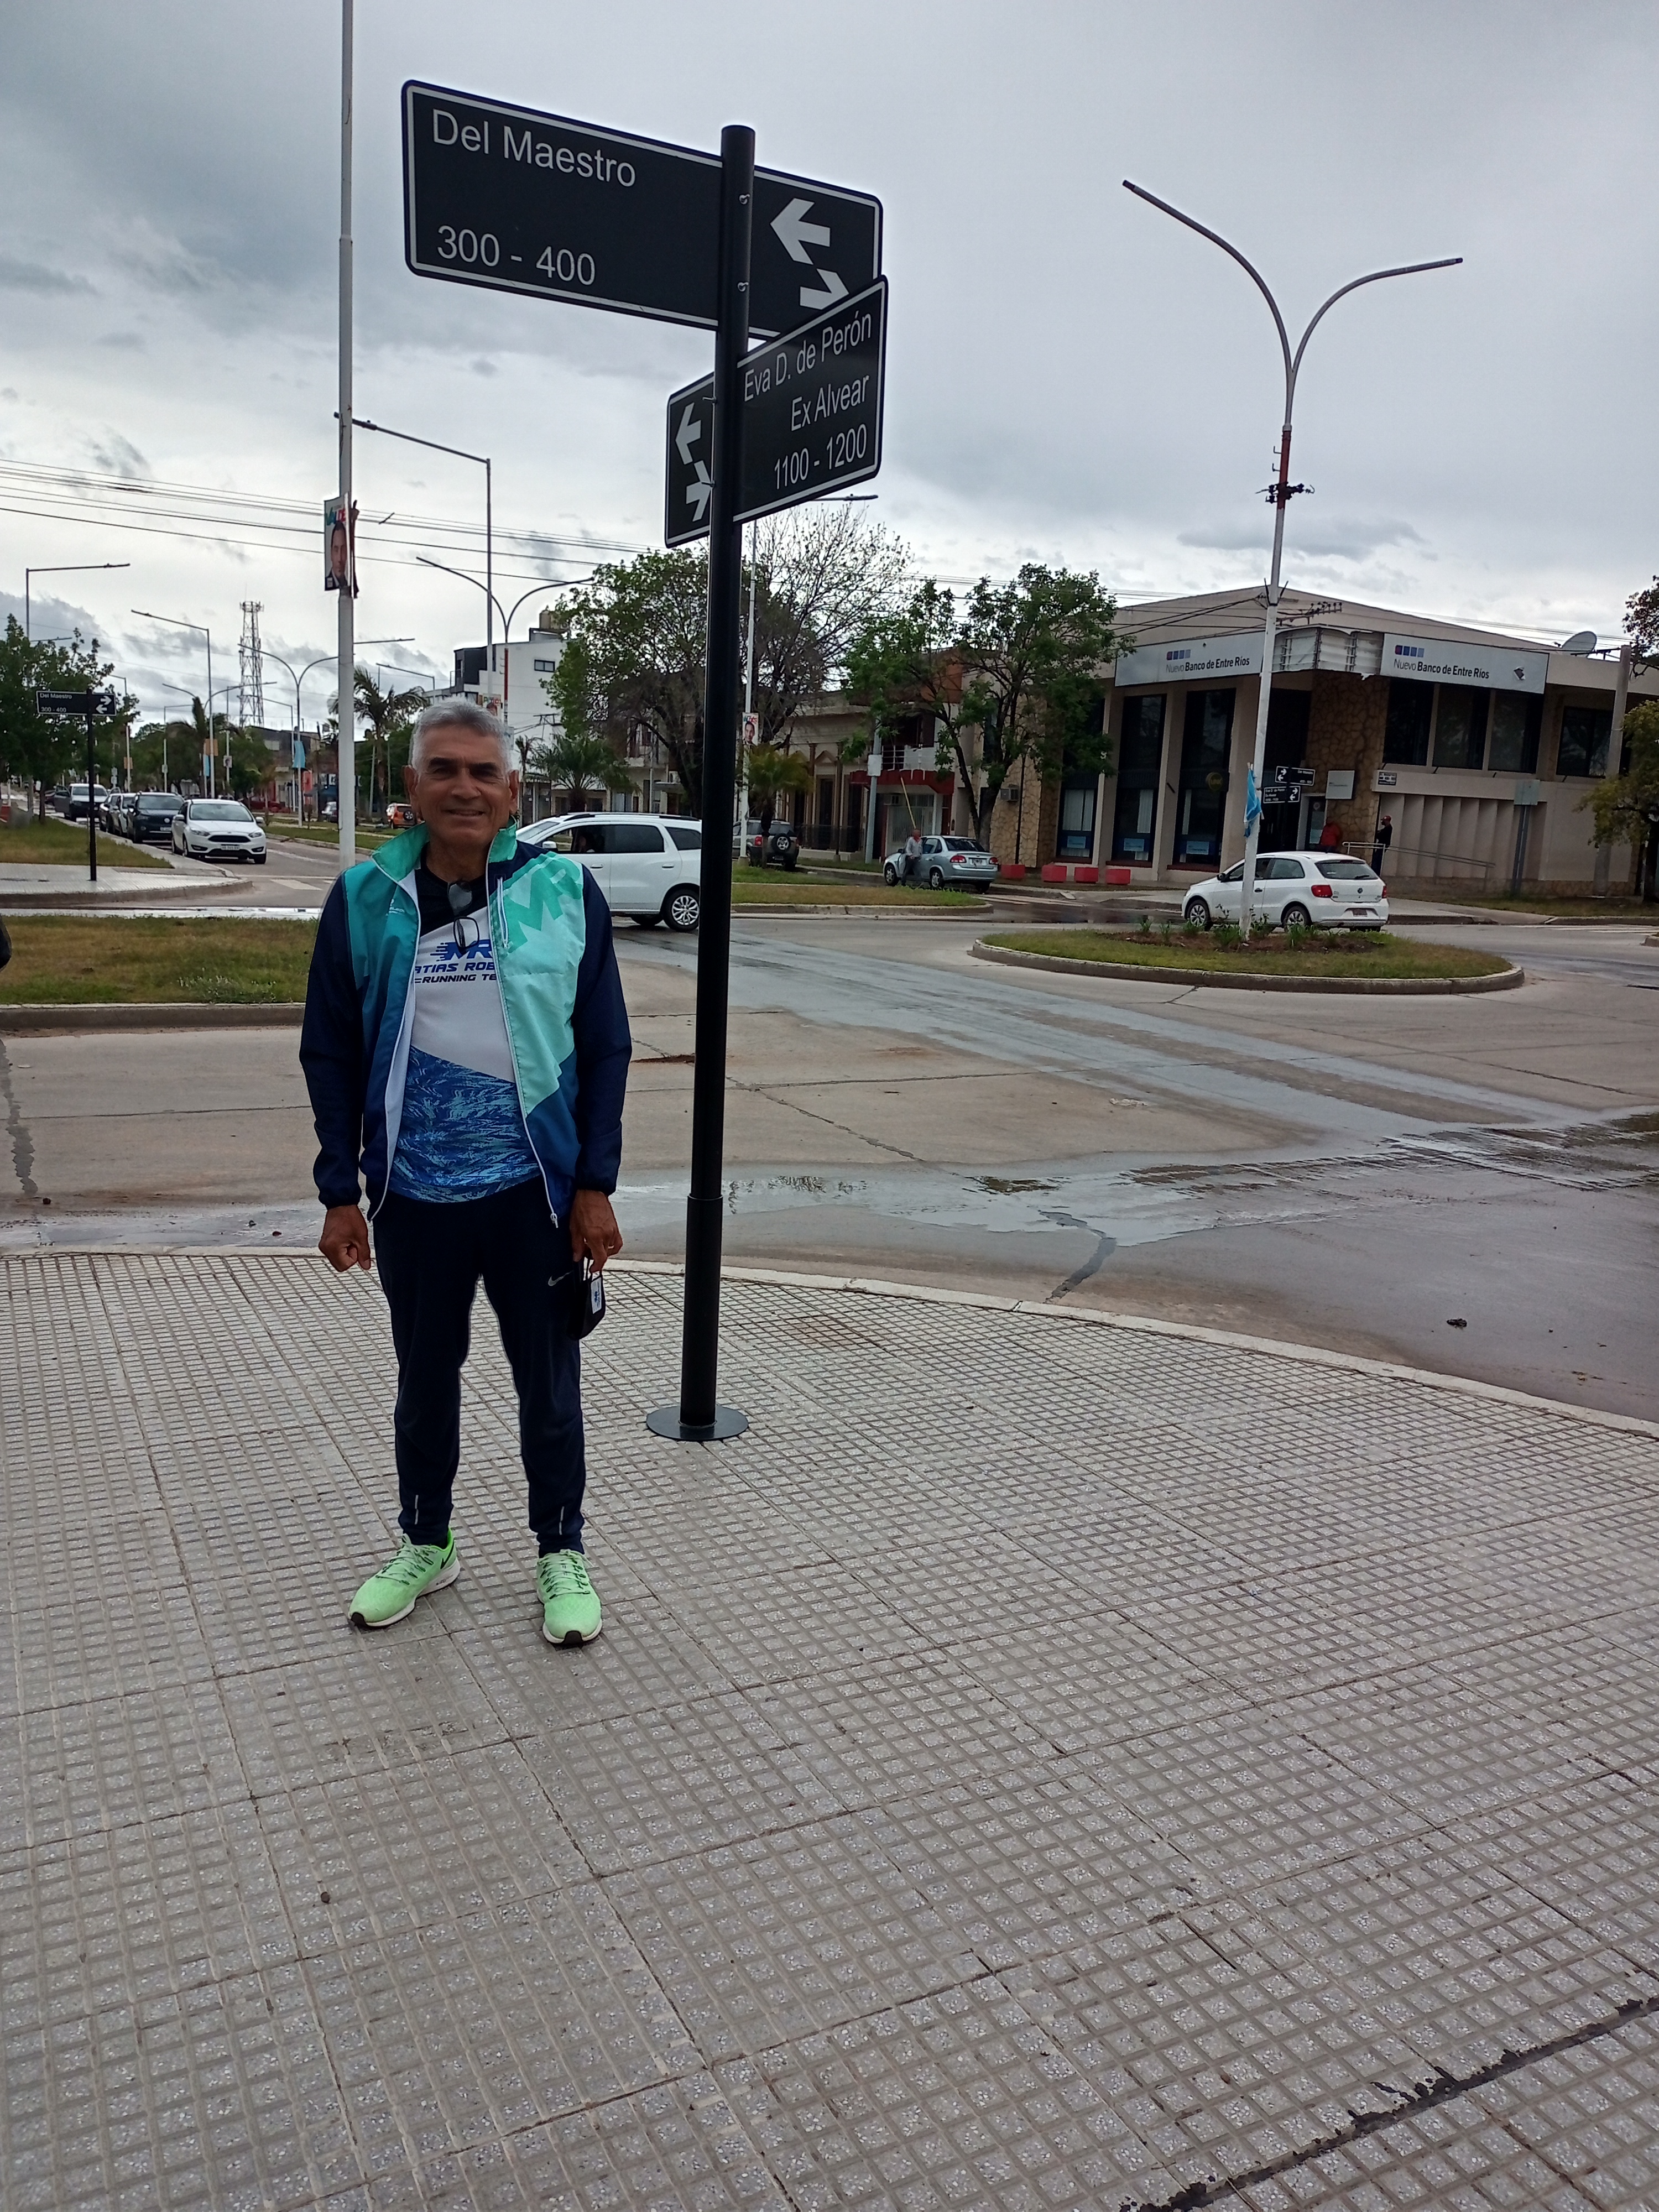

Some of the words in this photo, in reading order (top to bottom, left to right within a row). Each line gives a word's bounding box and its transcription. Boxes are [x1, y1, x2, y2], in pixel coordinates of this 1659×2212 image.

[433, 108, 489, 155] Del
[504, 126, 635, 187] Maestro
[437, 225, 499, 267] 300
[536, 246, 596, 285] 400
[744, 368, 770, 401] Eva
[776, 352, 791, 385] D.
[797, 340, 816, 374] de
[821, 310, 871, 362] Perón
[791, 397, 811, 431] Ex
[814, 375, 869, 422] Alvear
[774, 448, 808, 489] 1100
[827, 424, 867, 469] 1200
[1166, 664, 1185, 673] Nuevo
[1185, 662, 1205, 671] Banco
[1206, 660, 1214, 669] de
[1215, 659, 1233, 669] Entre
[1234, 656, 1250, 666] Ríos
[1394, 659, 1417, 670] Nuevo
[1417, 661, 1441, 674] Banco
[1442, 665, 1452, 675] de
[1453, 665, 1473, 677] Entre
[1473, 668, 1489, 679] Ríos
[422, 974, 477, 983] RUNNING
